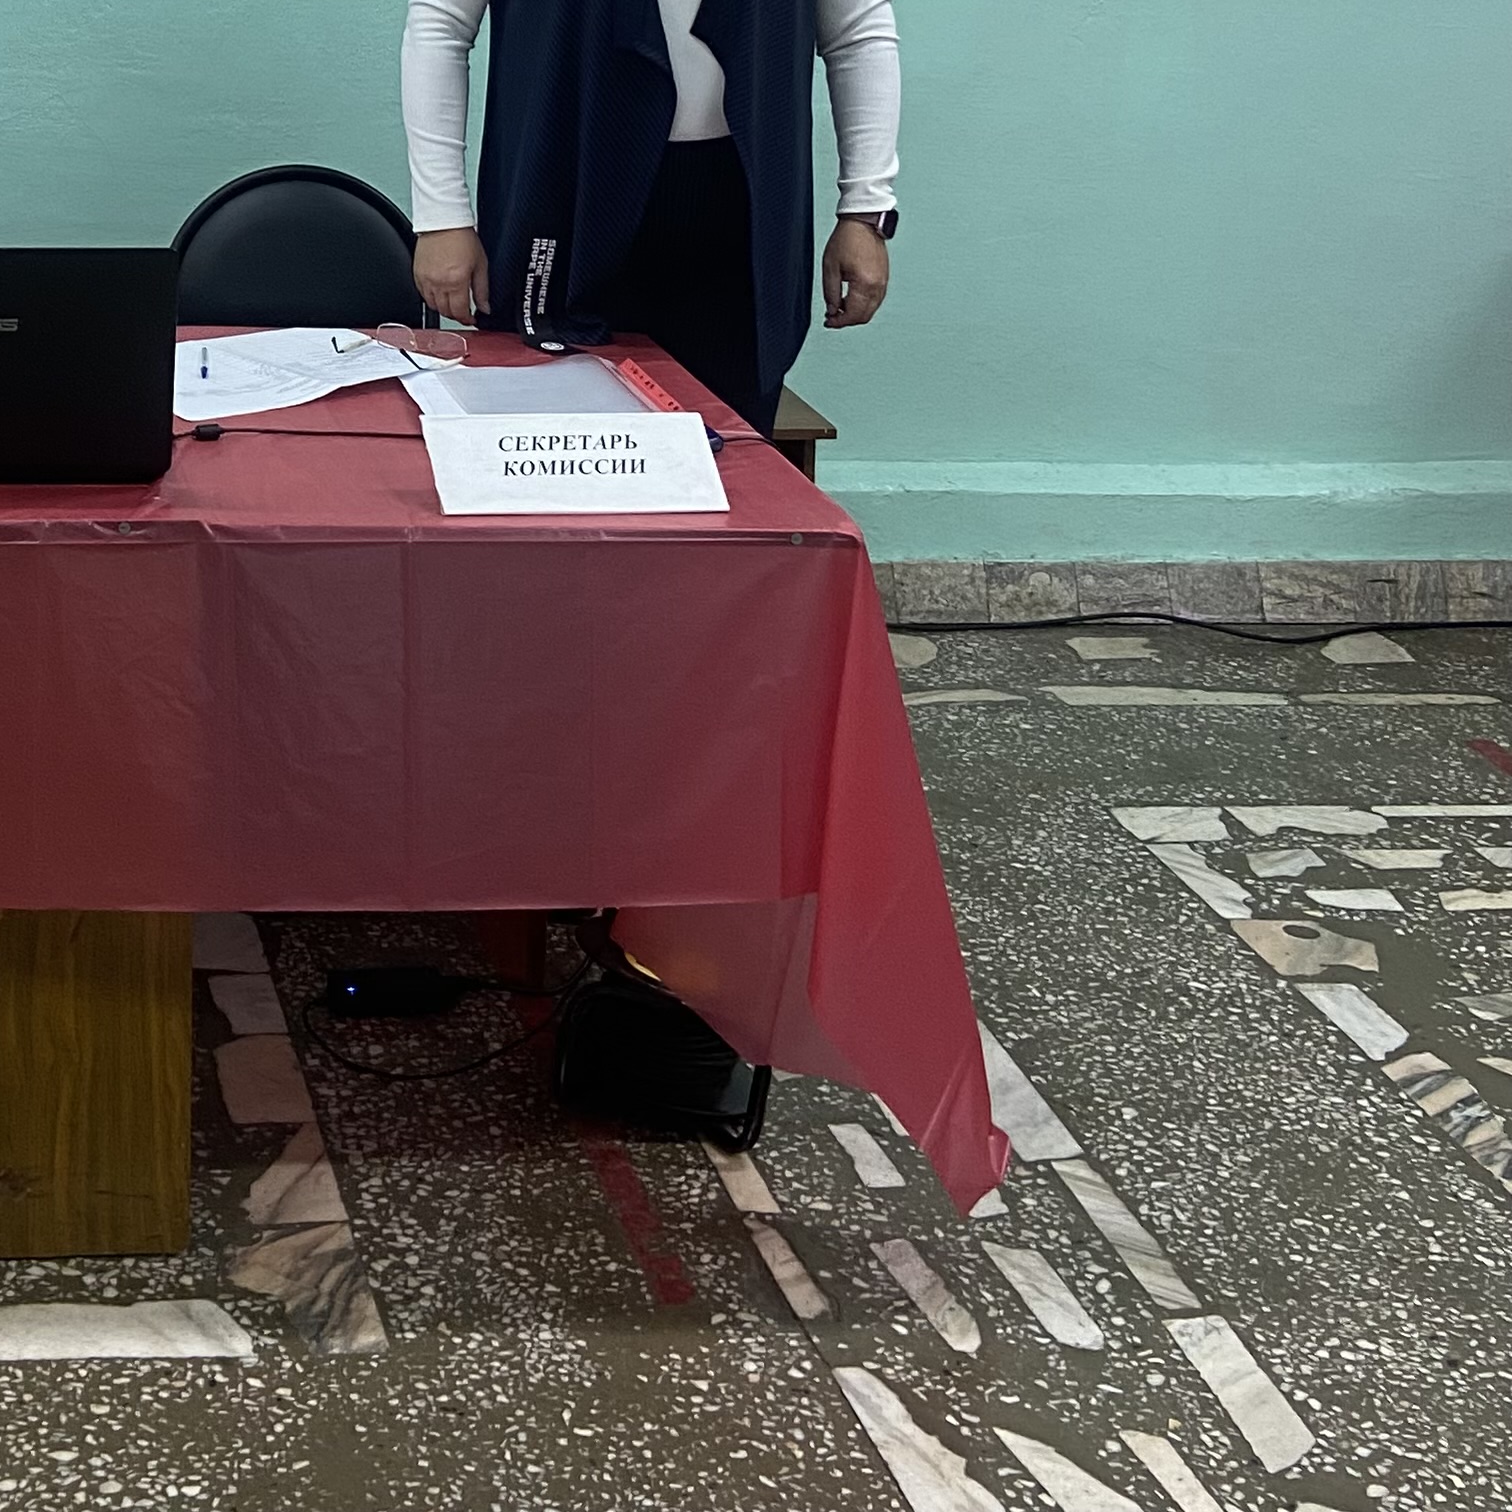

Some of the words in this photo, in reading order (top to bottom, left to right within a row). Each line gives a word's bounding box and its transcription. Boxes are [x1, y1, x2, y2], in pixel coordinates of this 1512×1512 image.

[539, 238, 549, 250] IN
[535, 253, 546, 276] THE
[536, 239, 557, 315] SOMEWHERE
[523, 273, 535, 335] UNIVERSE
[498, 434, 639, 453] СЕКРЕТАРЬ
[503, 458, 647, 476] КОМИССИИ
